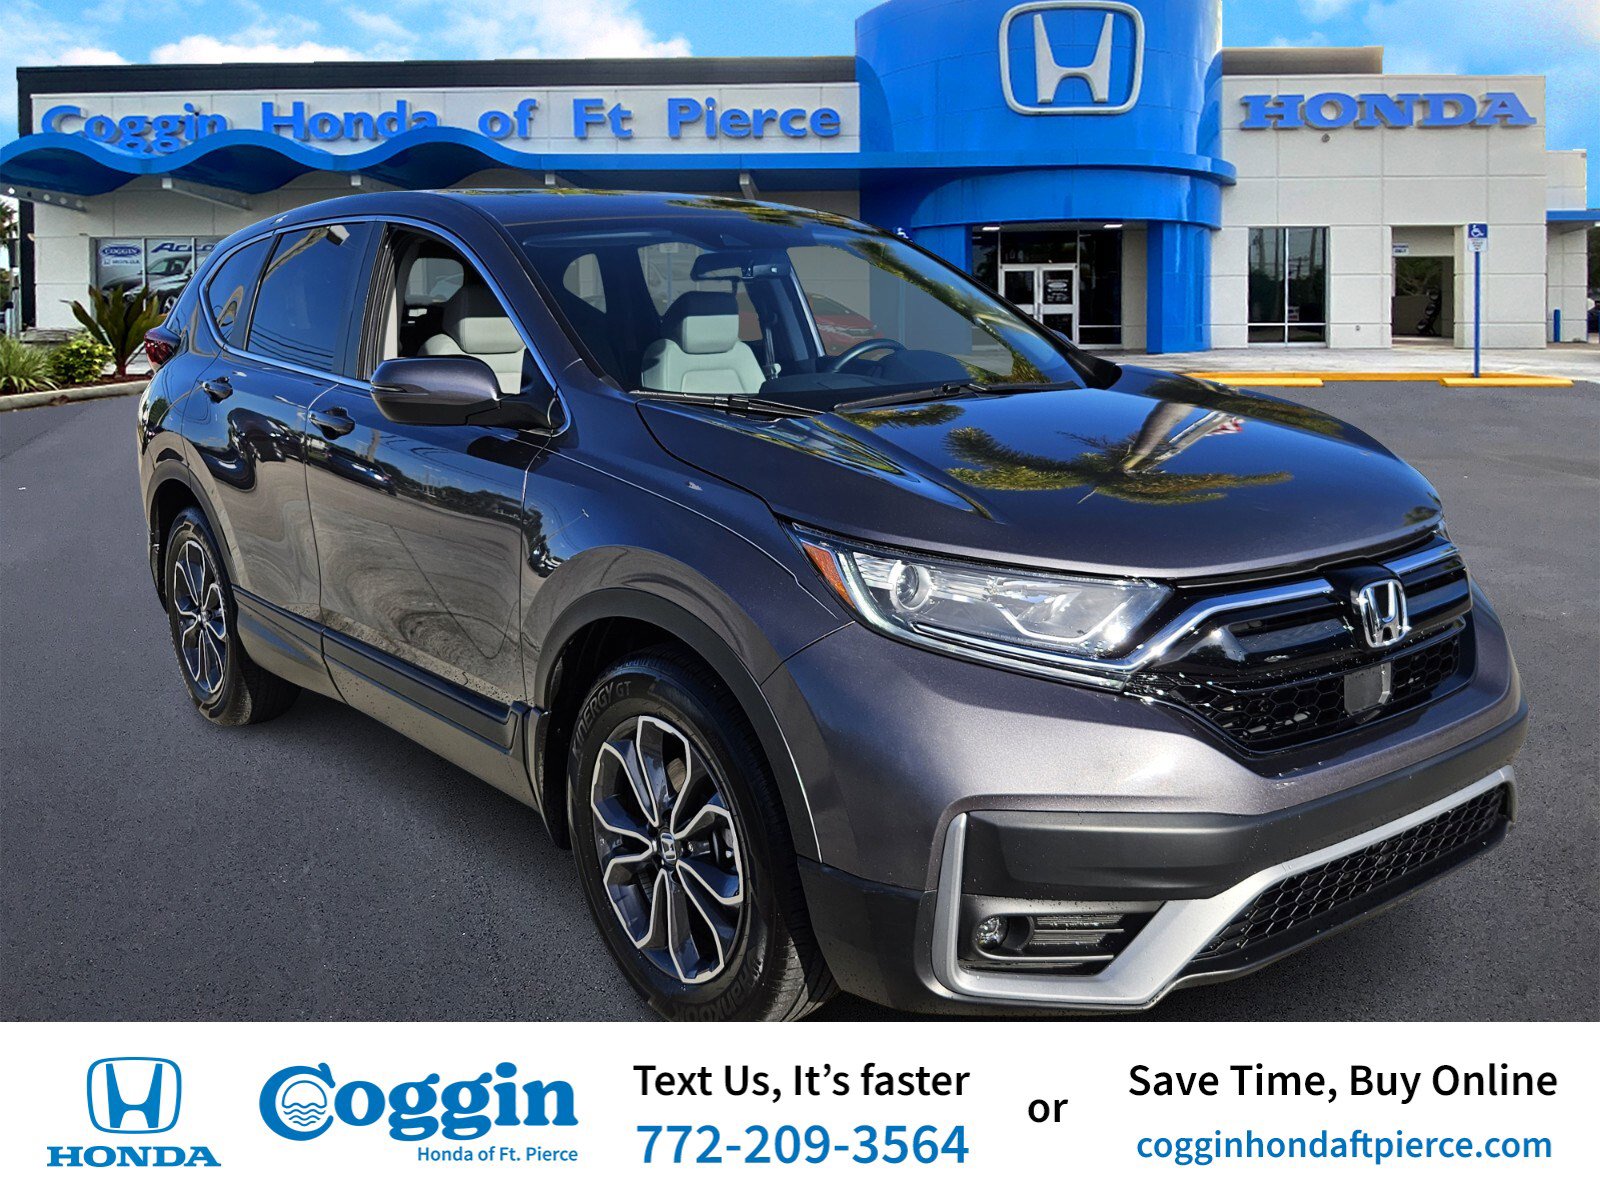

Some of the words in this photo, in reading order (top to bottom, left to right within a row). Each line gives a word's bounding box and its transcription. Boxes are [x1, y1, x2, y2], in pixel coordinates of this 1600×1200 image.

[41, 102, 228, 154] Coggin
[261, 100, 439, 142] Honda
[477, 98, 539, 140] of
[573, 97, 634, 139] Ft
[667, 96, 842, 139] Pierce
[1240, 91, 1537, 130] HONDA
[616, 680, 632, 698] GT
